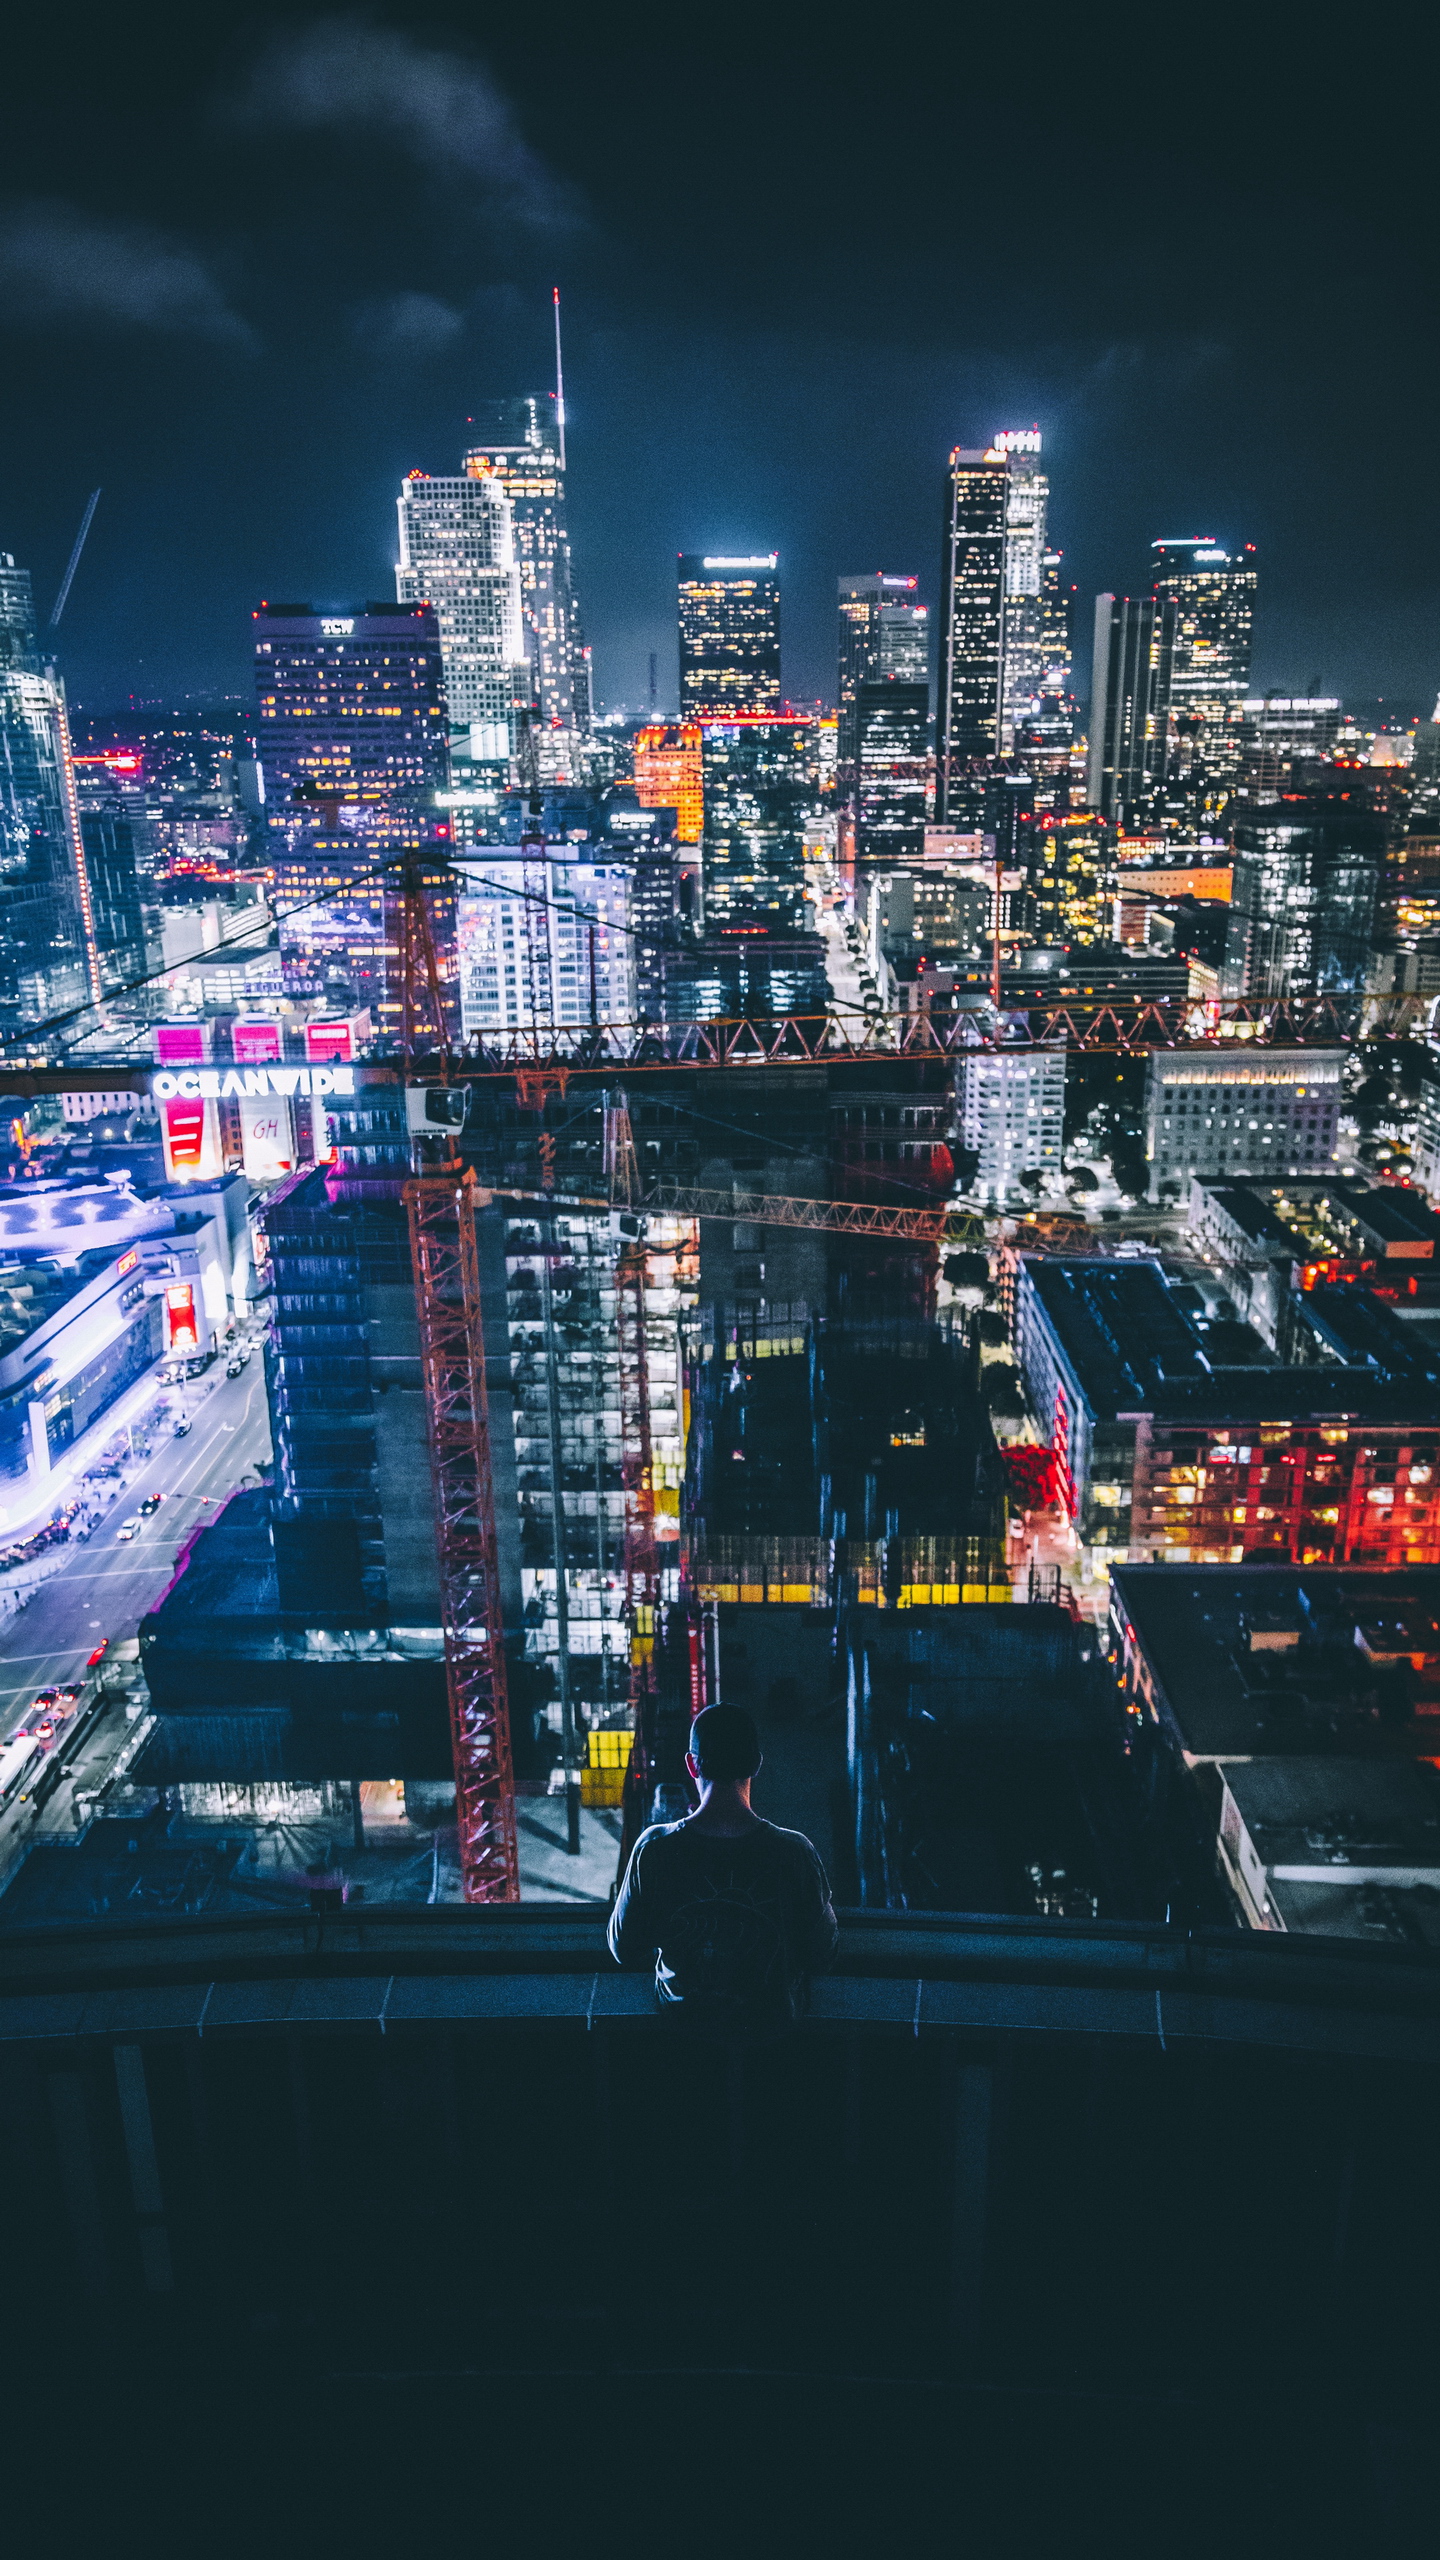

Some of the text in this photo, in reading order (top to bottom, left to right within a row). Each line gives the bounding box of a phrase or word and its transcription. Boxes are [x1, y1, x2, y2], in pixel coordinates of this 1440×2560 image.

[321, 619, 354, 634] TCW
[244, 980, 324, 993] FIGUEROA
[153, 1068, 354, 1098] OCEANWIDE
